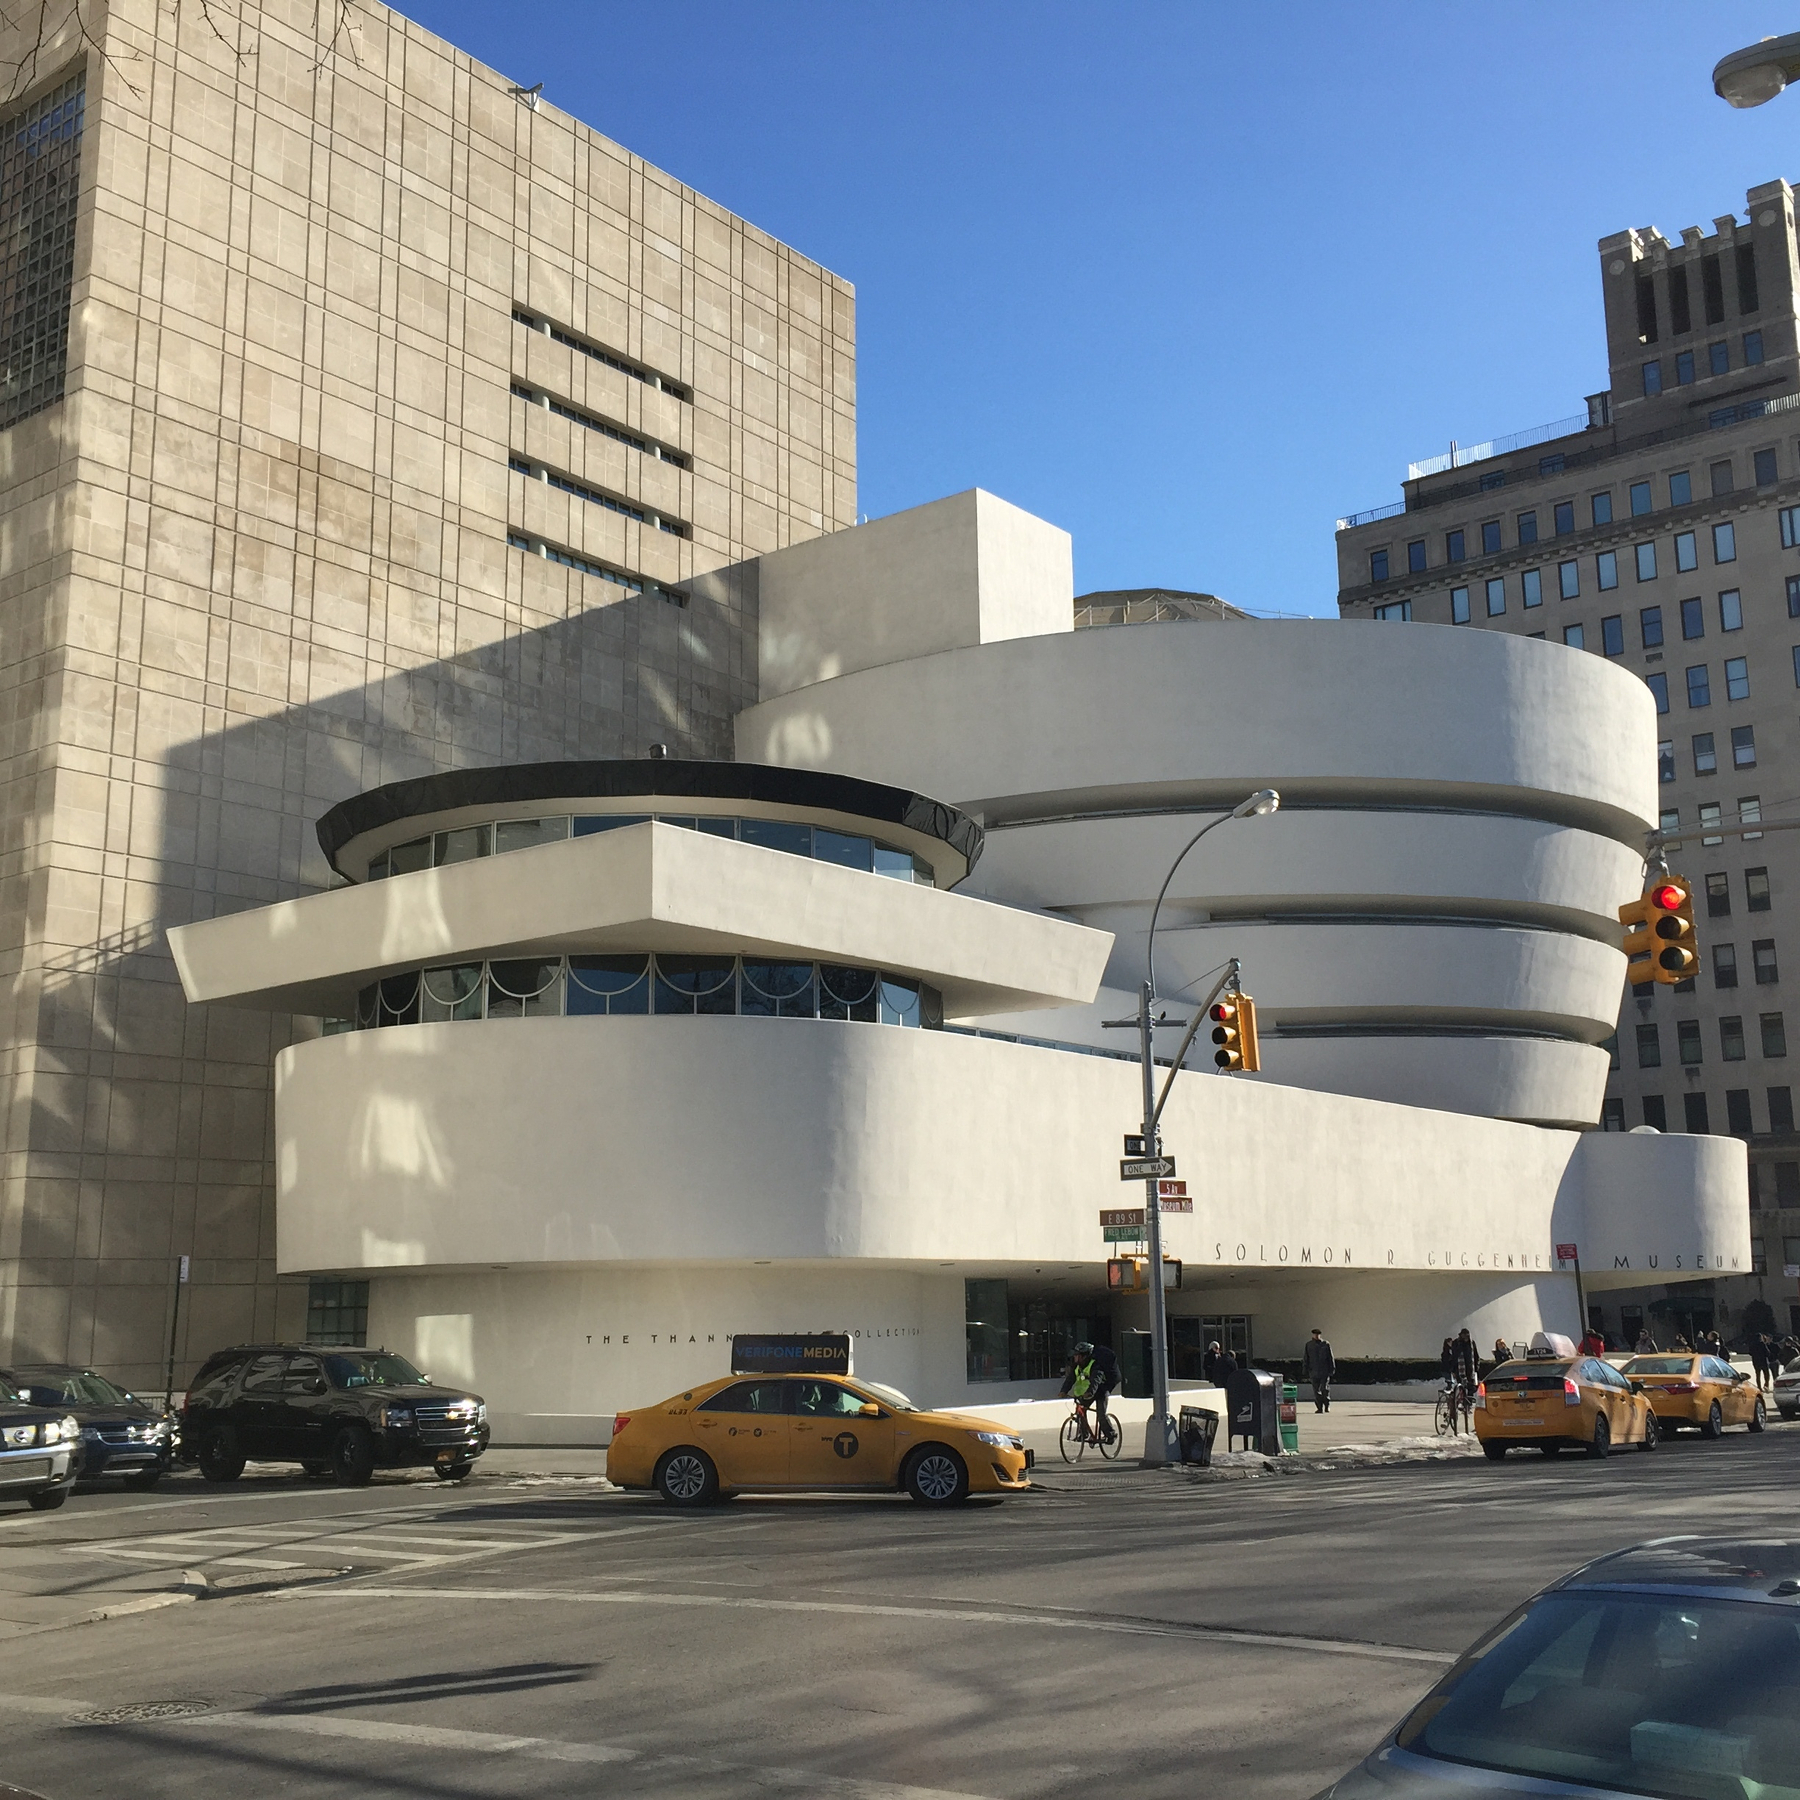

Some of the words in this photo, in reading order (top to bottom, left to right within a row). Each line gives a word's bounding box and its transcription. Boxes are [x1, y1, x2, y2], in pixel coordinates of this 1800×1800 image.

[1128, 1165, 1144, 1174] ONE
[1150, 1163, 1167, 1172] WAY
[1108, 1213, 1113, 1224] E
[1115, 1213, 1126, 1224] 89
[1214, 1242, 1351, 1264] SOLOMON
[1387, 1248, 1395, 1266] R
[1427, 1250, 1567, 1270] GUGGENHEIM
[1613, 1254, 1740, 1270] MUSEUM
[586, 1335, 630, 1344] THE
